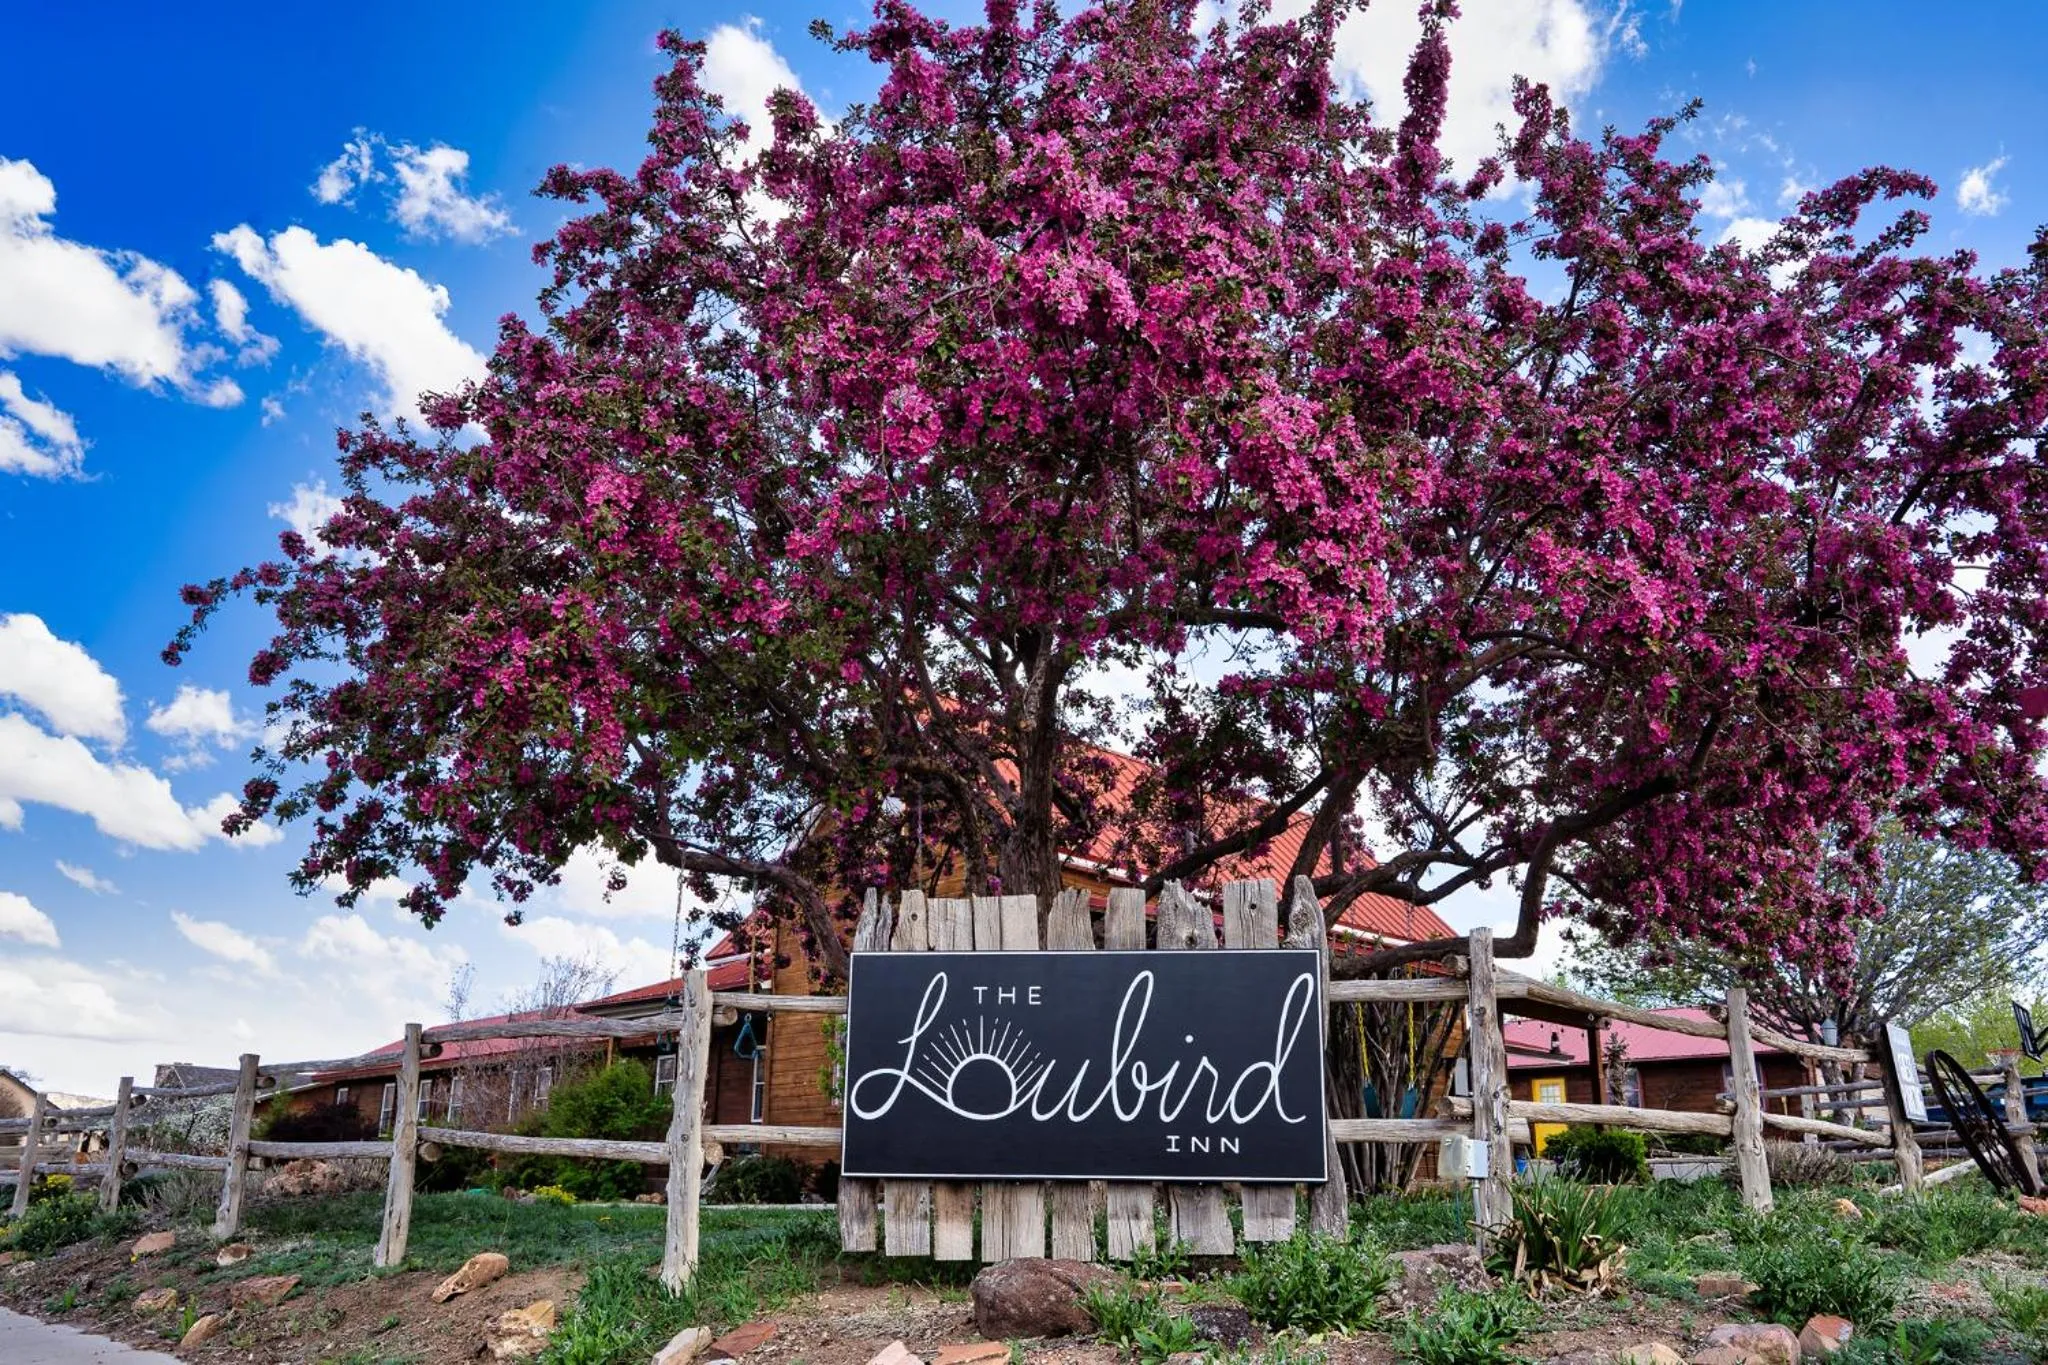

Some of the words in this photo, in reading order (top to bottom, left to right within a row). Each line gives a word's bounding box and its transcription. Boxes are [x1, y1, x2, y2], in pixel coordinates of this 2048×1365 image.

[973, 986, 1042, 1005] THE
[850, 970, 1314, 1124] Loubird
[1166, 1135, 1240, 1154] INN
